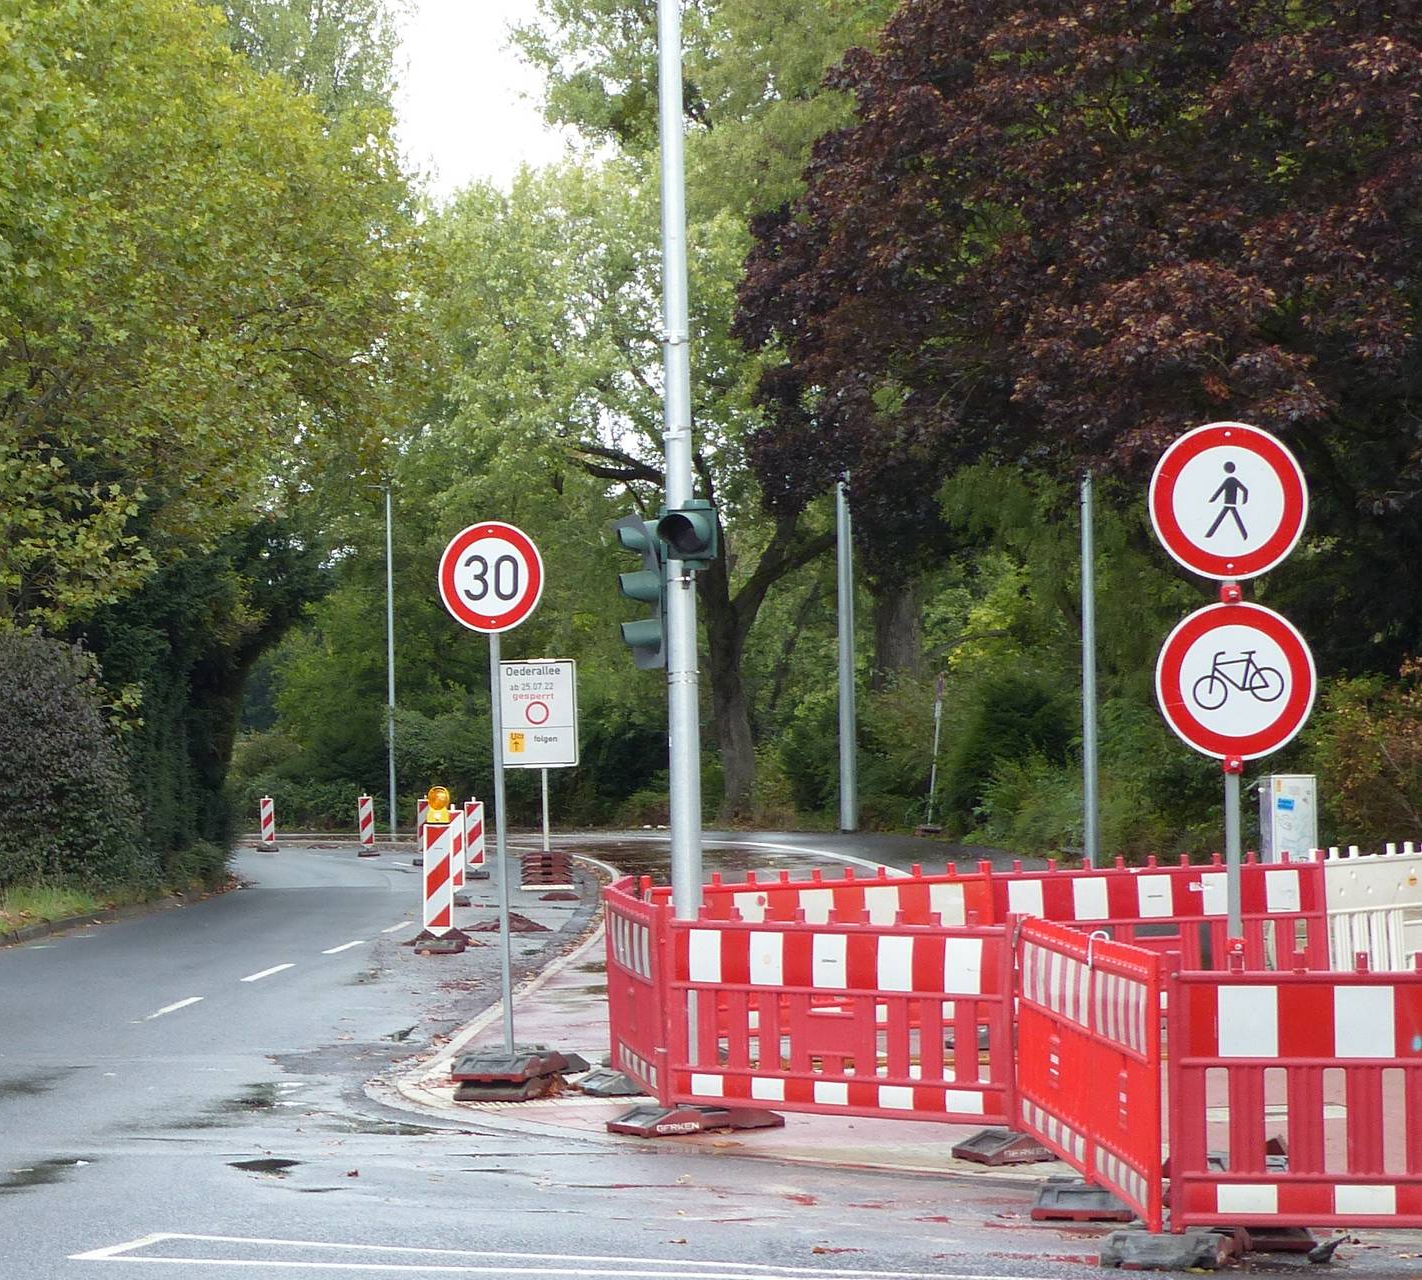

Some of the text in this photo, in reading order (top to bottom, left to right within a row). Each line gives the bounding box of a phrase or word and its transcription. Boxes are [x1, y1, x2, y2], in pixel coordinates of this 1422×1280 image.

[464, 554, 519, 601] 30
[506, 667, 561, 677] Oederallee
[513, 693, 554, 701] gesperrt
[534, 735, 558, 744] folgen
[656, 1121, 700, 1134] GERKEN
